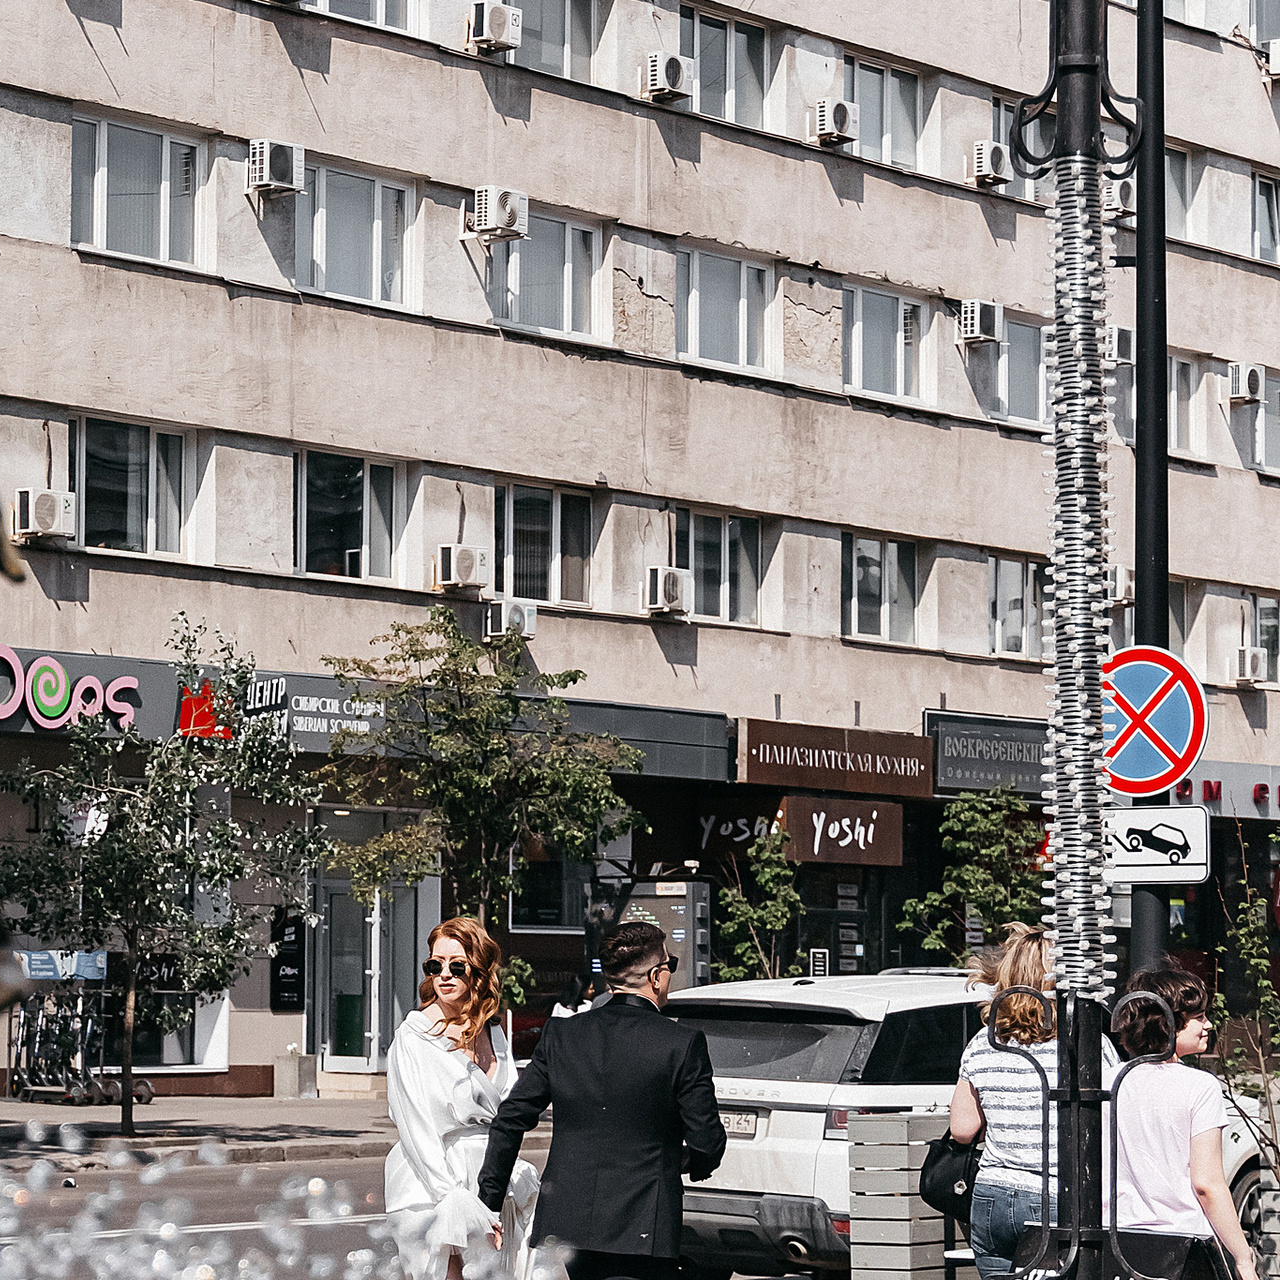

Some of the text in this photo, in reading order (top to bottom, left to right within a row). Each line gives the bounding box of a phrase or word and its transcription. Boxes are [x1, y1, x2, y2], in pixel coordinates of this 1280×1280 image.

[245, 677, 287, 710] ЦЕНТР
[291, 695, 341, 714] СИБИРСКИЕ
[292, 715, 328, 733] SIBERIAN
[716, 1087, 781, 1098] ROVER
